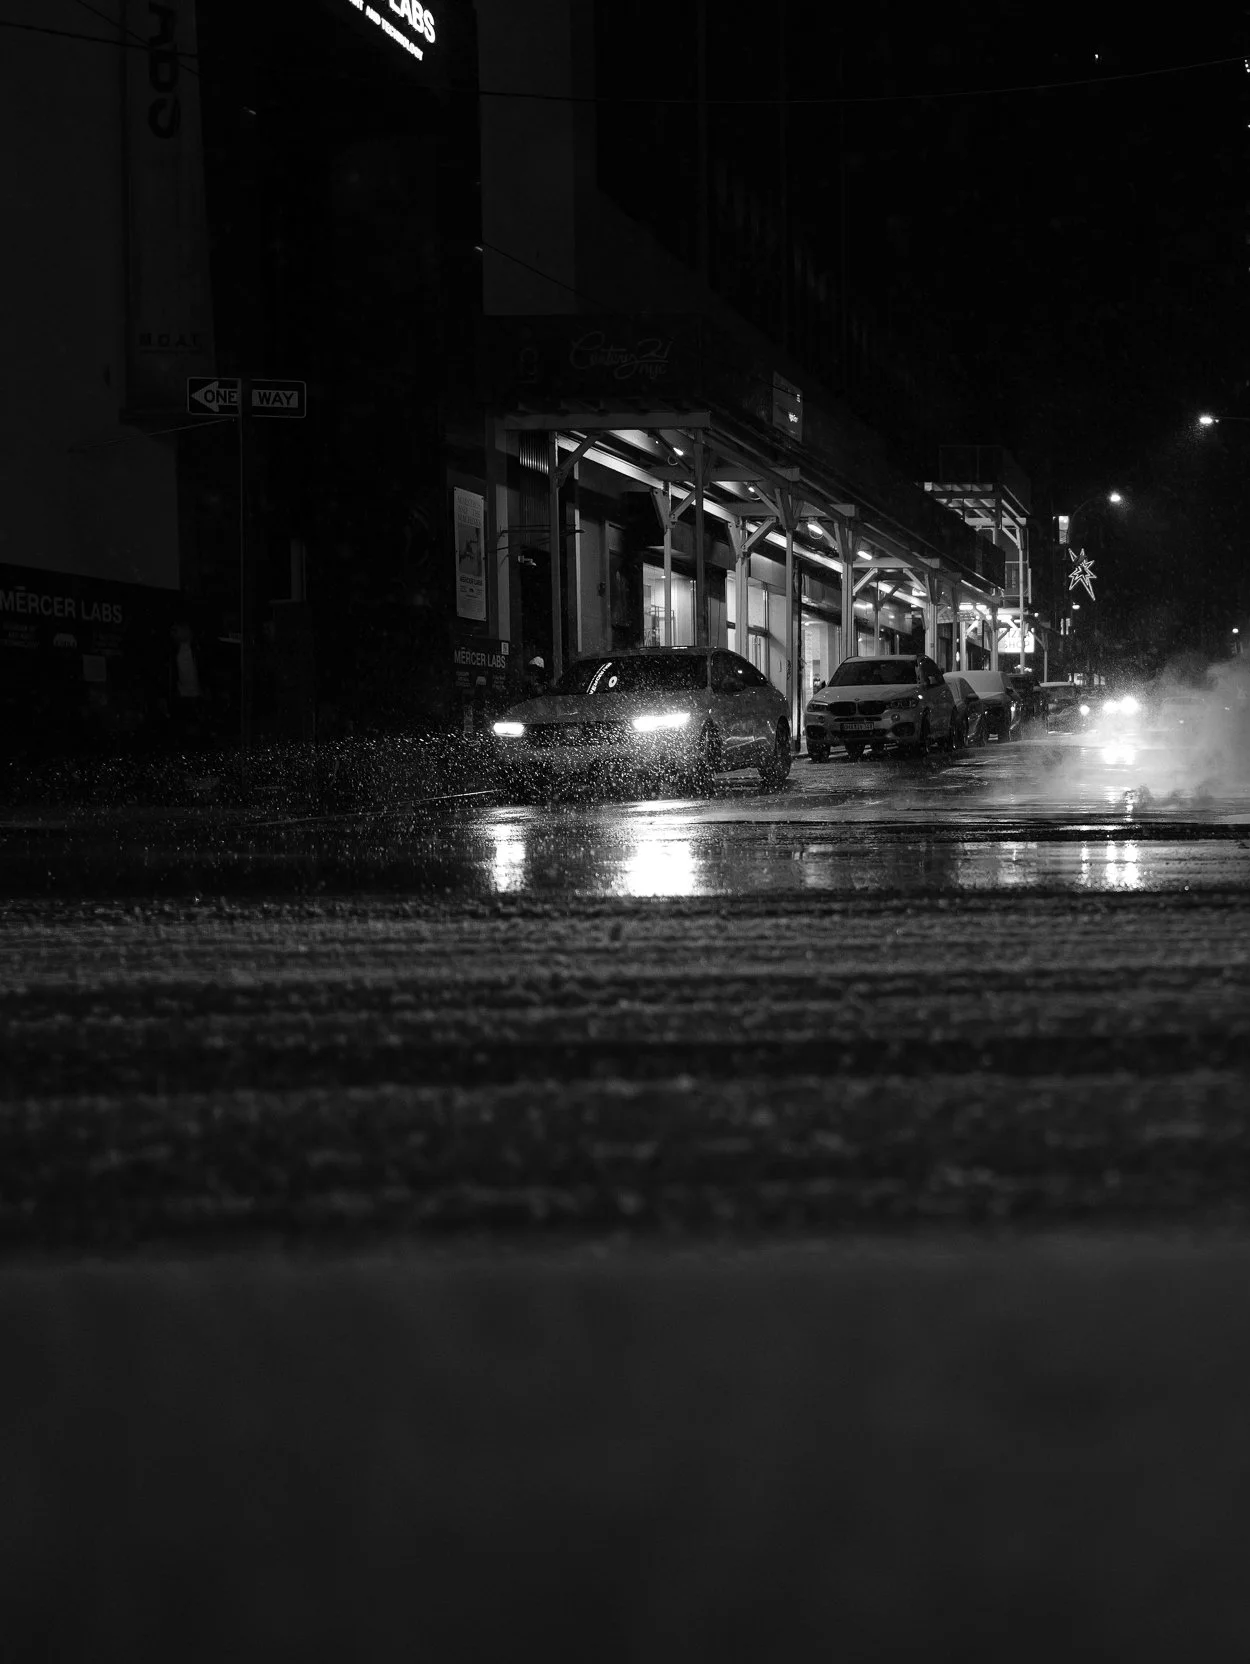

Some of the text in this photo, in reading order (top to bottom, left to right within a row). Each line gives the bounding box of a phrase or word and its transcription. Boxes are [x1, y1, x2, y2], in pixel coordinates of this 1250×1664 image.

[569, 331, 674, 380] Century 21
[204, 390, 294, 405] ONE WAY
[81, 599, 122, 624] LABS
[487, 653, 506, 668] LABS
